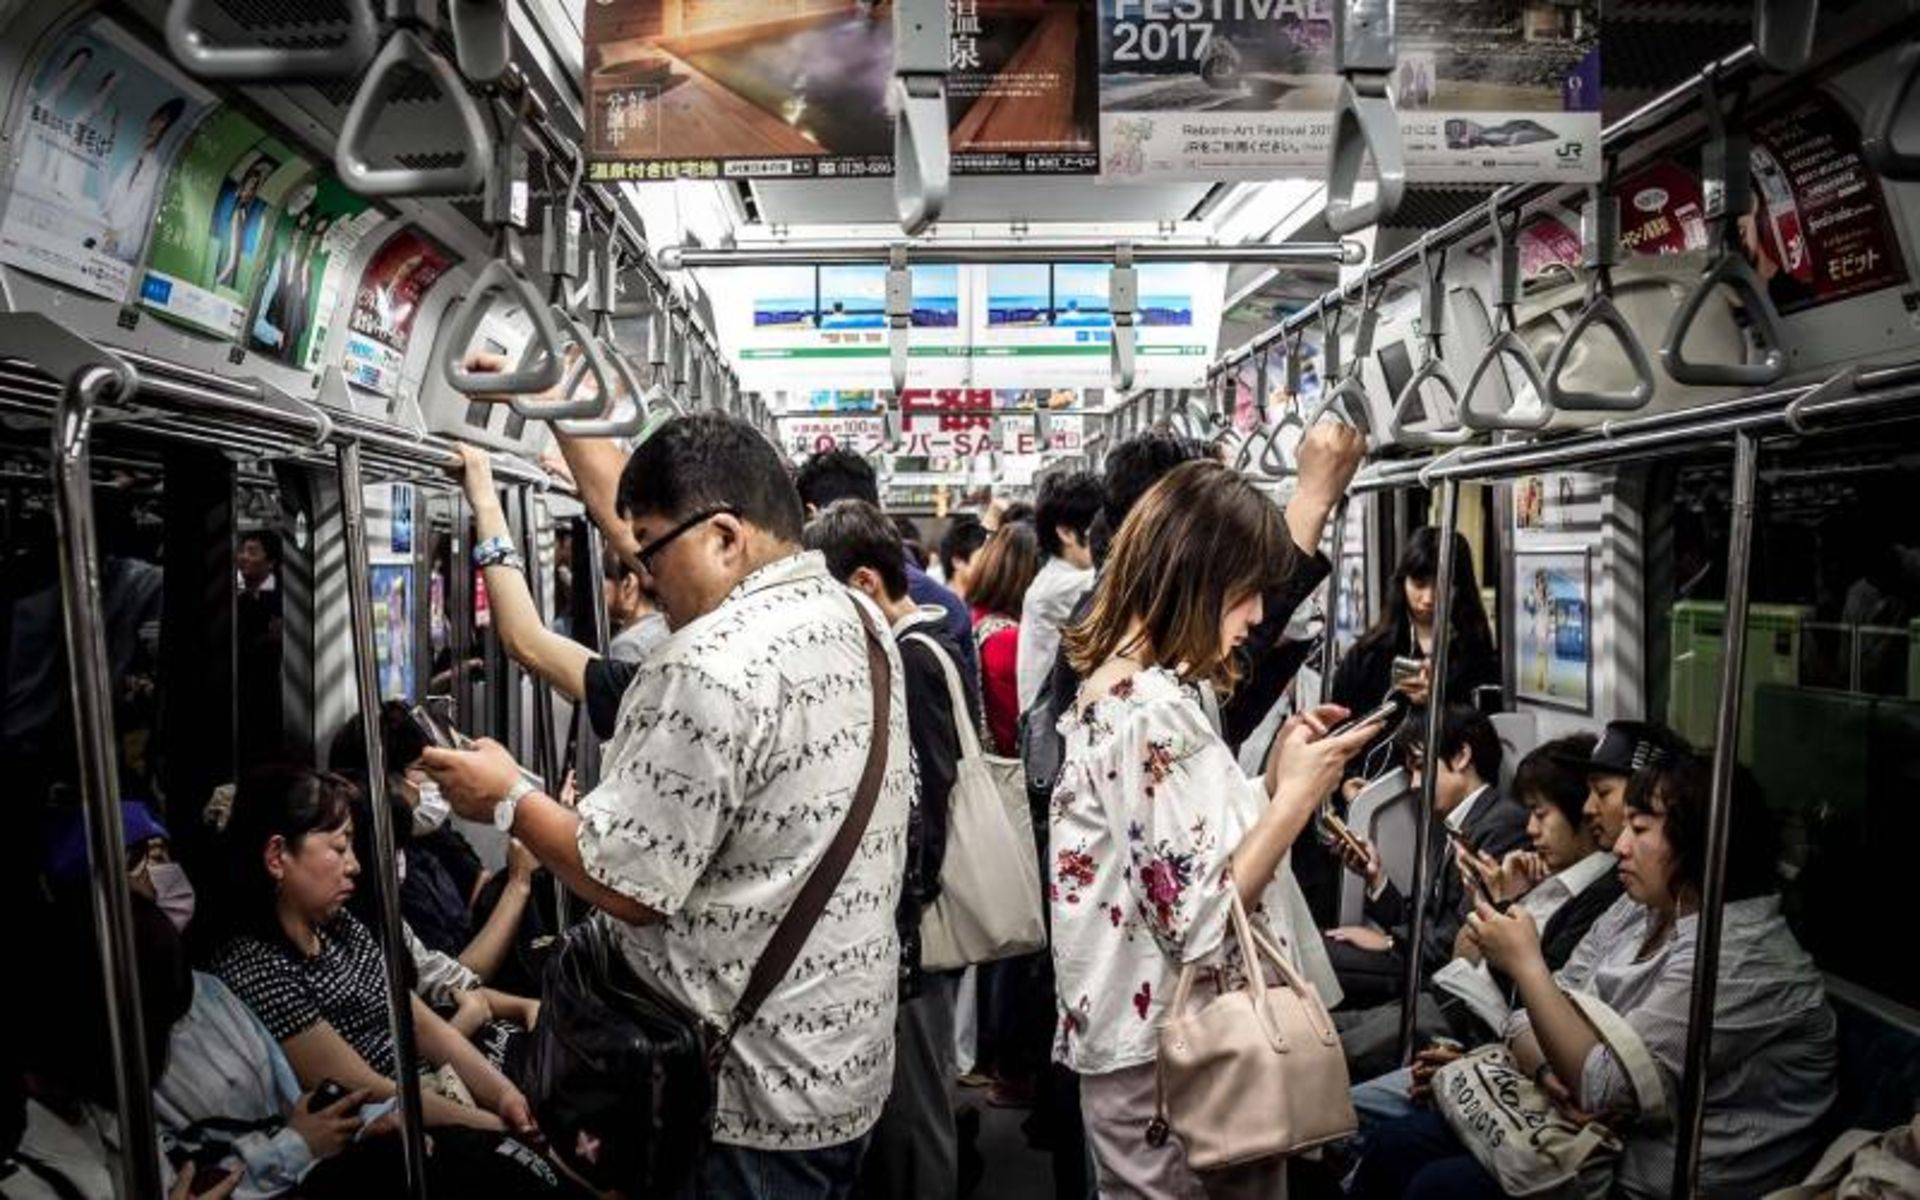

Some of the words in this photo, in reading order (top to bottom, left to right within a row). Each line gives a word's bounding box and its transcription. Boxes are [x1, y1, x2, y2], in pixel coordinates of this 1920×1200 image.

[1112, 23, 1213, 61] 2017
[1257, 124, 1306, 136] Festival
[1555, 143, 1583, 157] JR
